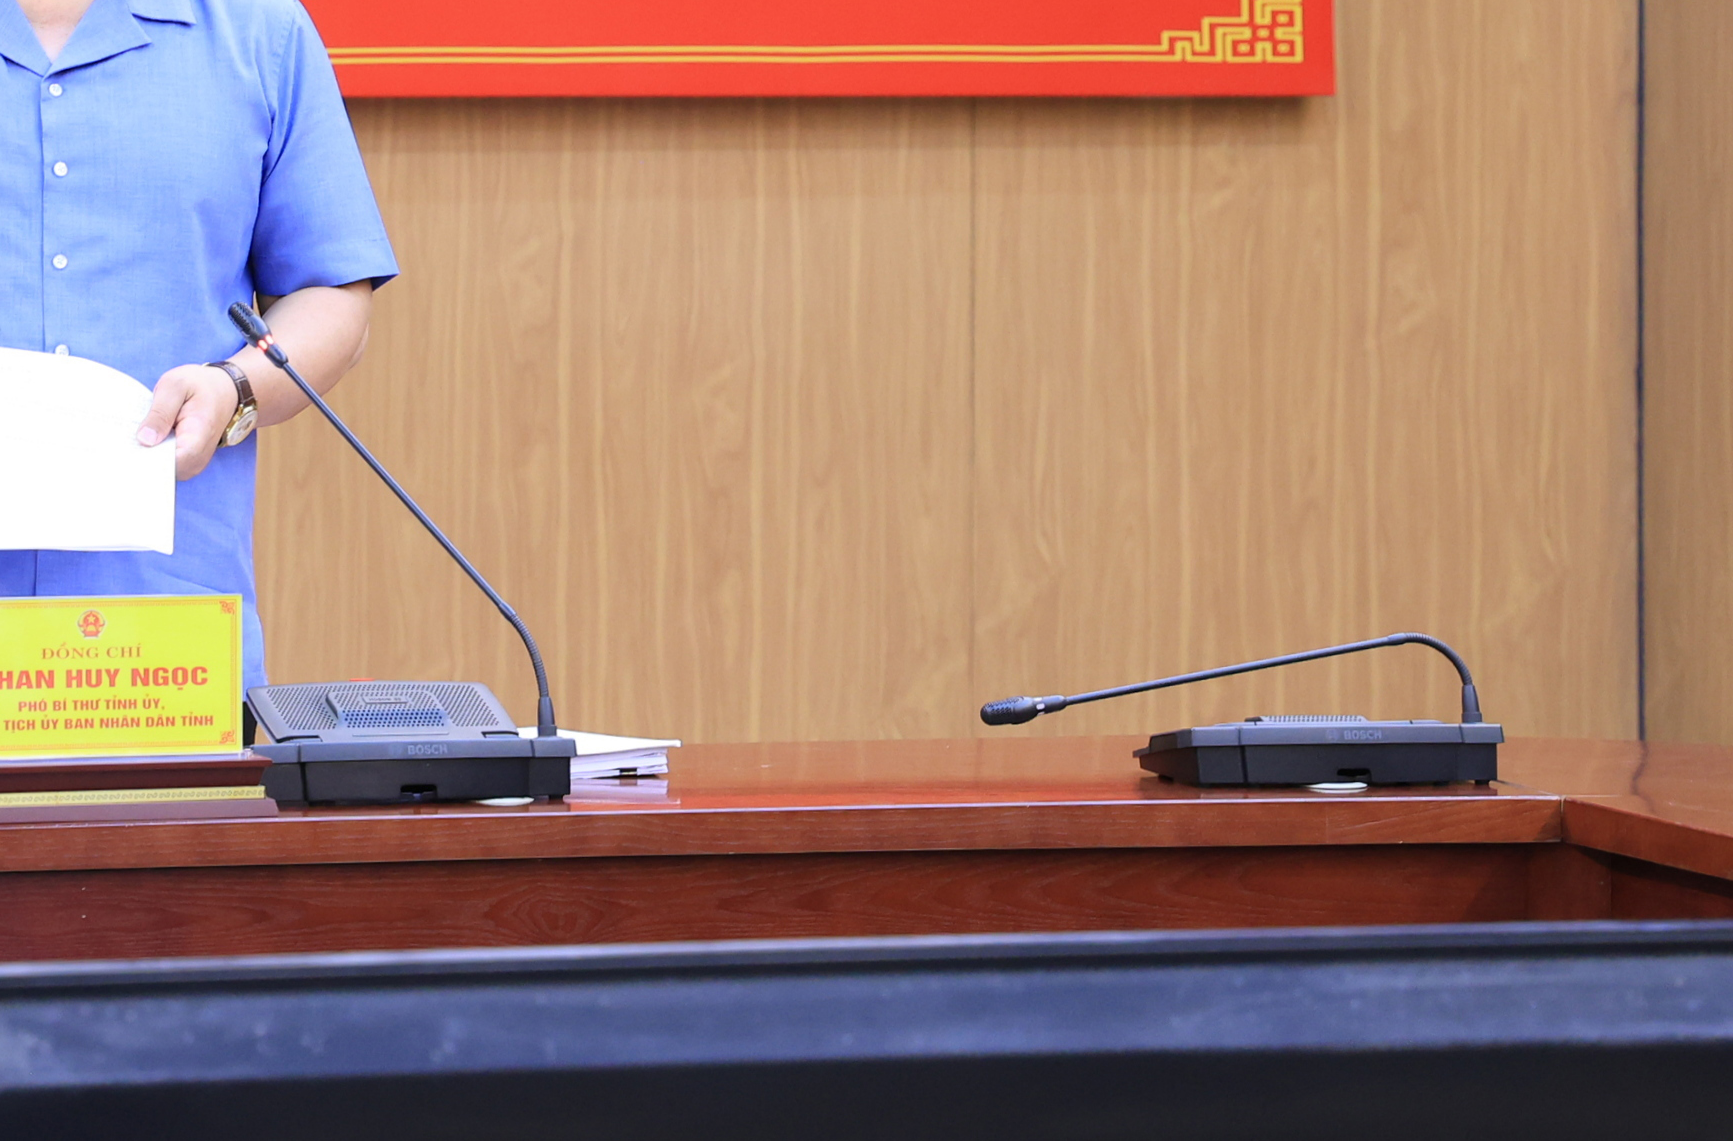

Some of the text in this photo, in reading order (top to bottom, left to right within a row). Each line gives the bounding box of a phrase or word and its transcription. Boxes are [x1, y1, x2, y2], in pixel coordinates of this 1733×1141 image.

[106, 643, 142, 658] CHÍ
[66, 668, 120, 688] HUY
[130, 666, 208, 691] NGỌC
[18, 697, 47, 712] PHÓ
[52, 697, 67, 712] BÍ
[72, 697, 101, 711] THƯ
[104, 695, 138, 710] TỈNH
[3, 718, 36, 733] TỊCH
[40, 714, 59, 730] ỦY
[64, 717, 95, 729] BAN
[99, 714, 141, 729] NHÂN
[145, 713, 176, 728] DÂN
[181, 711, 214, 727] TỈNH
[1343, 729, 1383, 741] BOSCH
[407, 743, 448, 755] BOSCH
